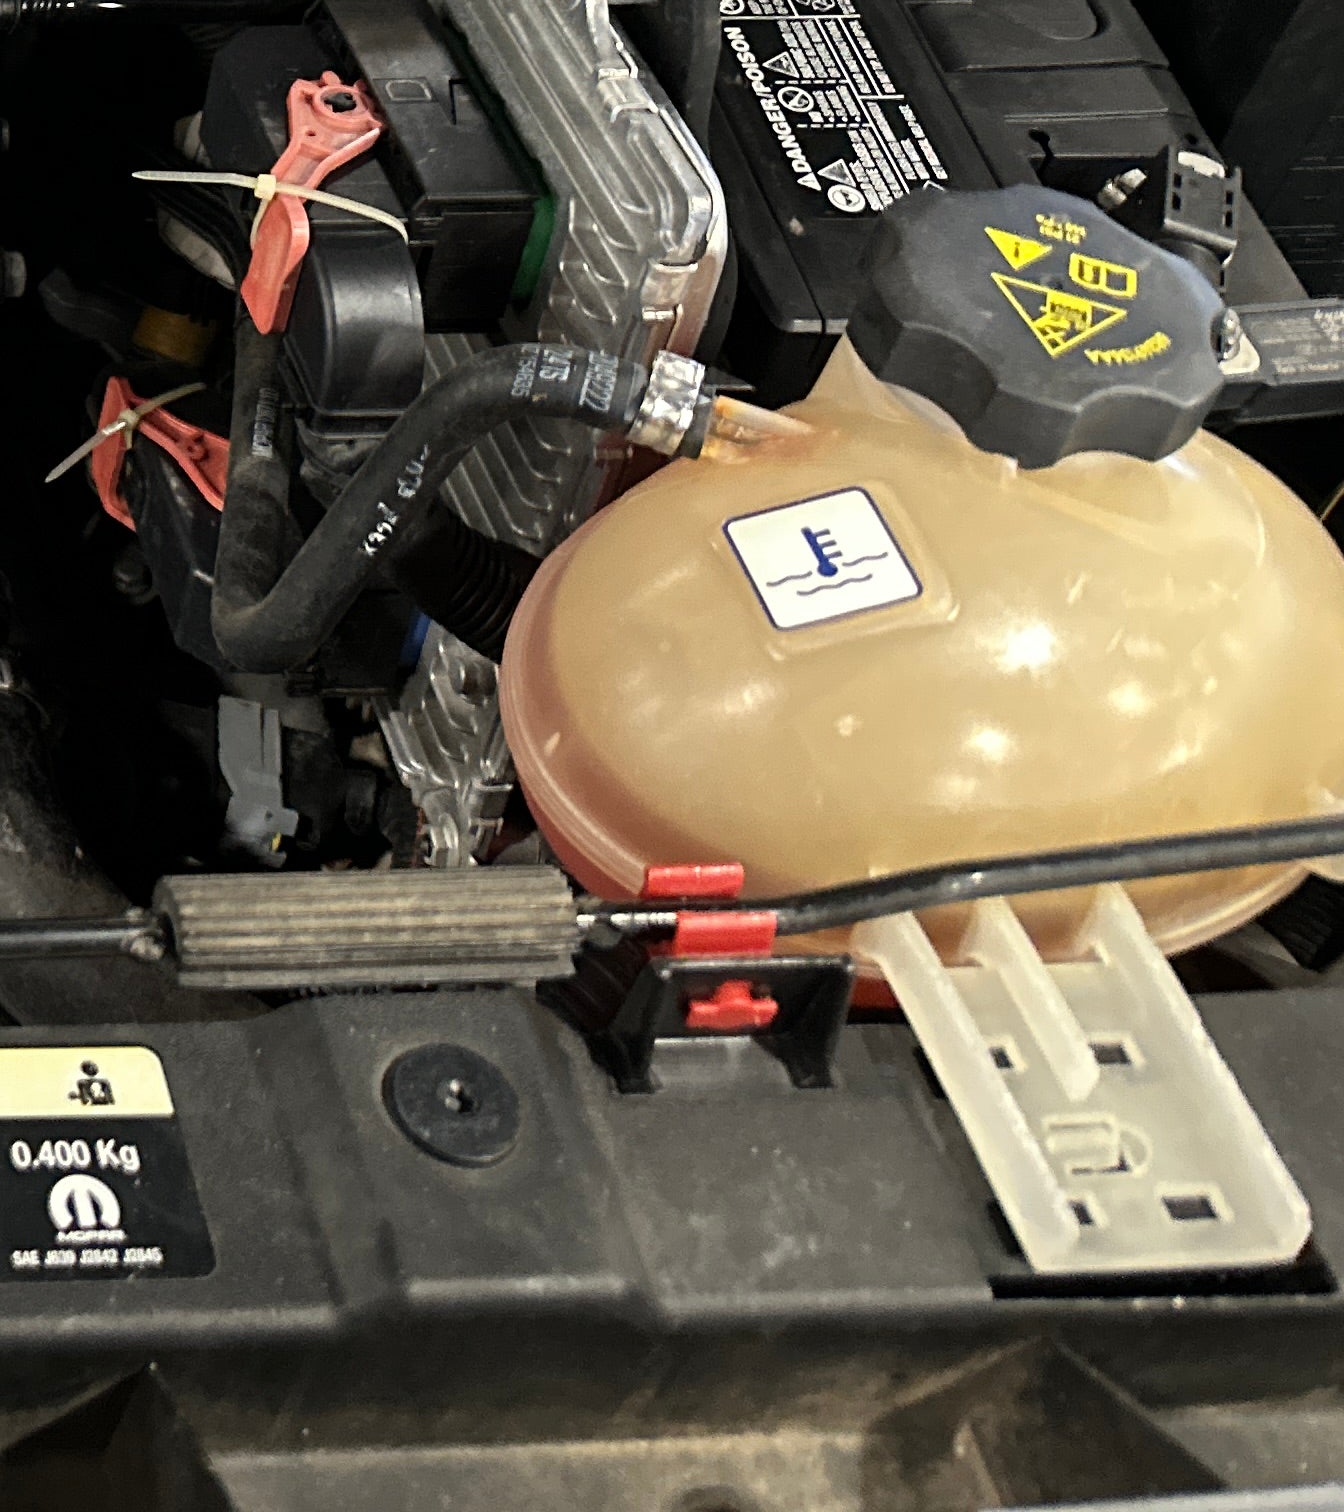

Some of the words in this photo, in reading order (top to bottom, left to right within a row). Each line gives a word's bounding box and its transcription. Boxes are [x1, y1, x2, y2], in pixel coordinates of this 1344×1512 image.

[722, 26, 813, 172] DANGER/POISON
[11, 1140, 90, 1171] 0.400
[95, 1140, 141, 1174] Kg
